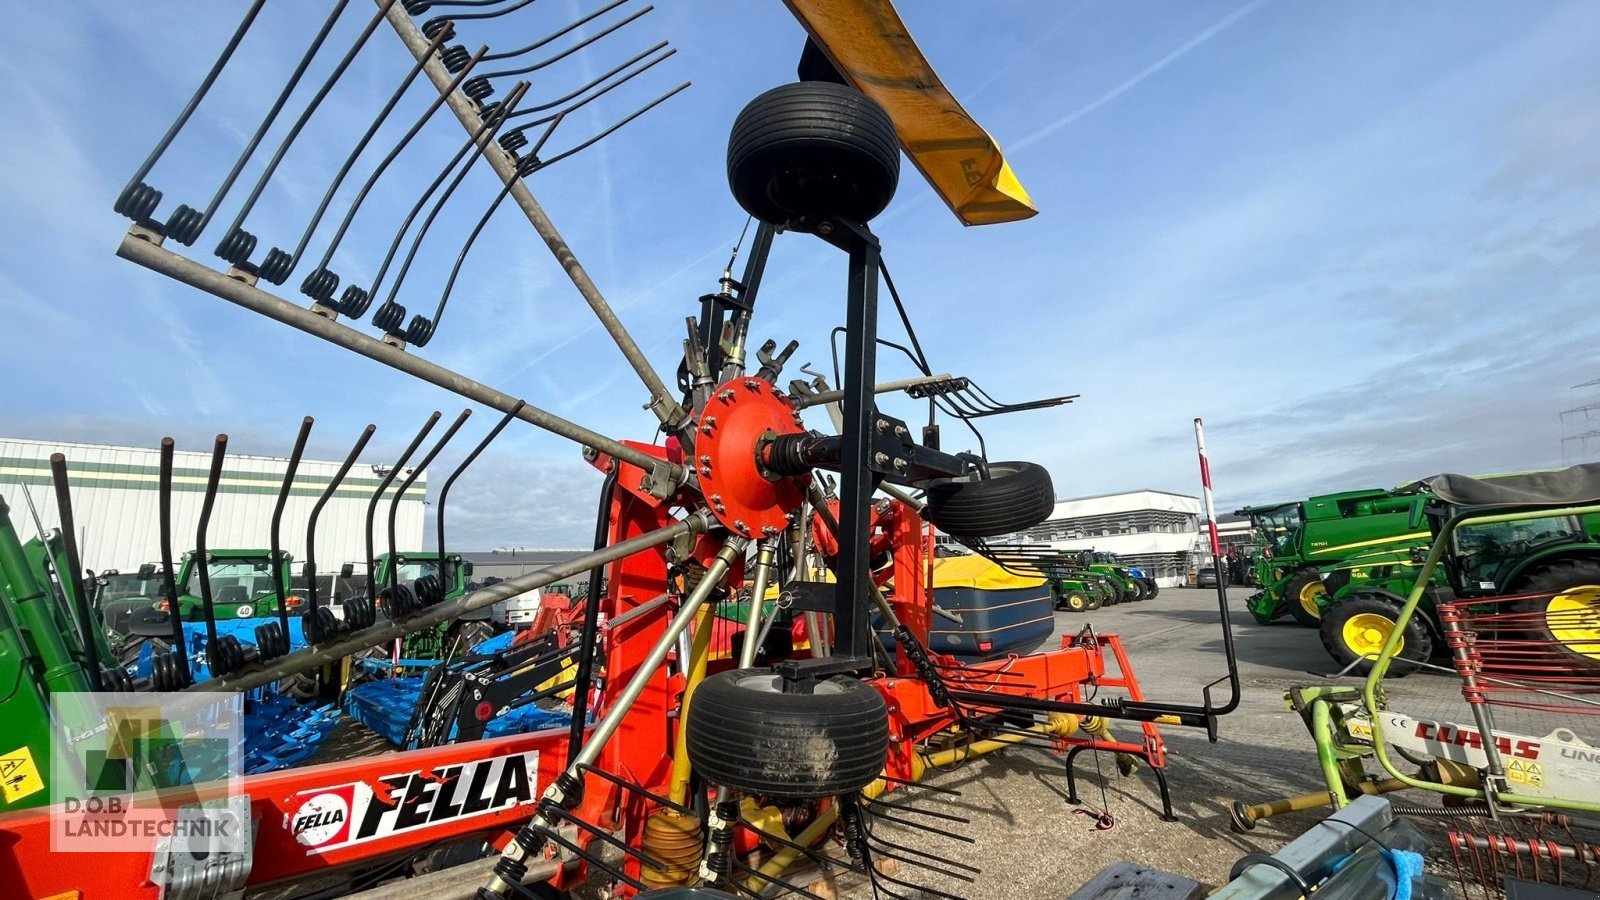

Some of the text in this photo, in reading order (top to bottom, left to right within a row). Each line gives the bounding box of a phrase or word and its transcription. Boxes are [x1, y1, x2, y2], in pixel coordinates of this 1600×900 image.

[240, 607, 250, 616] 40
[1415, 722, 1541, 760] CLAAS
[355, 754, 532, 840] FELLA
[293, 808, 344, 833] FELLA
